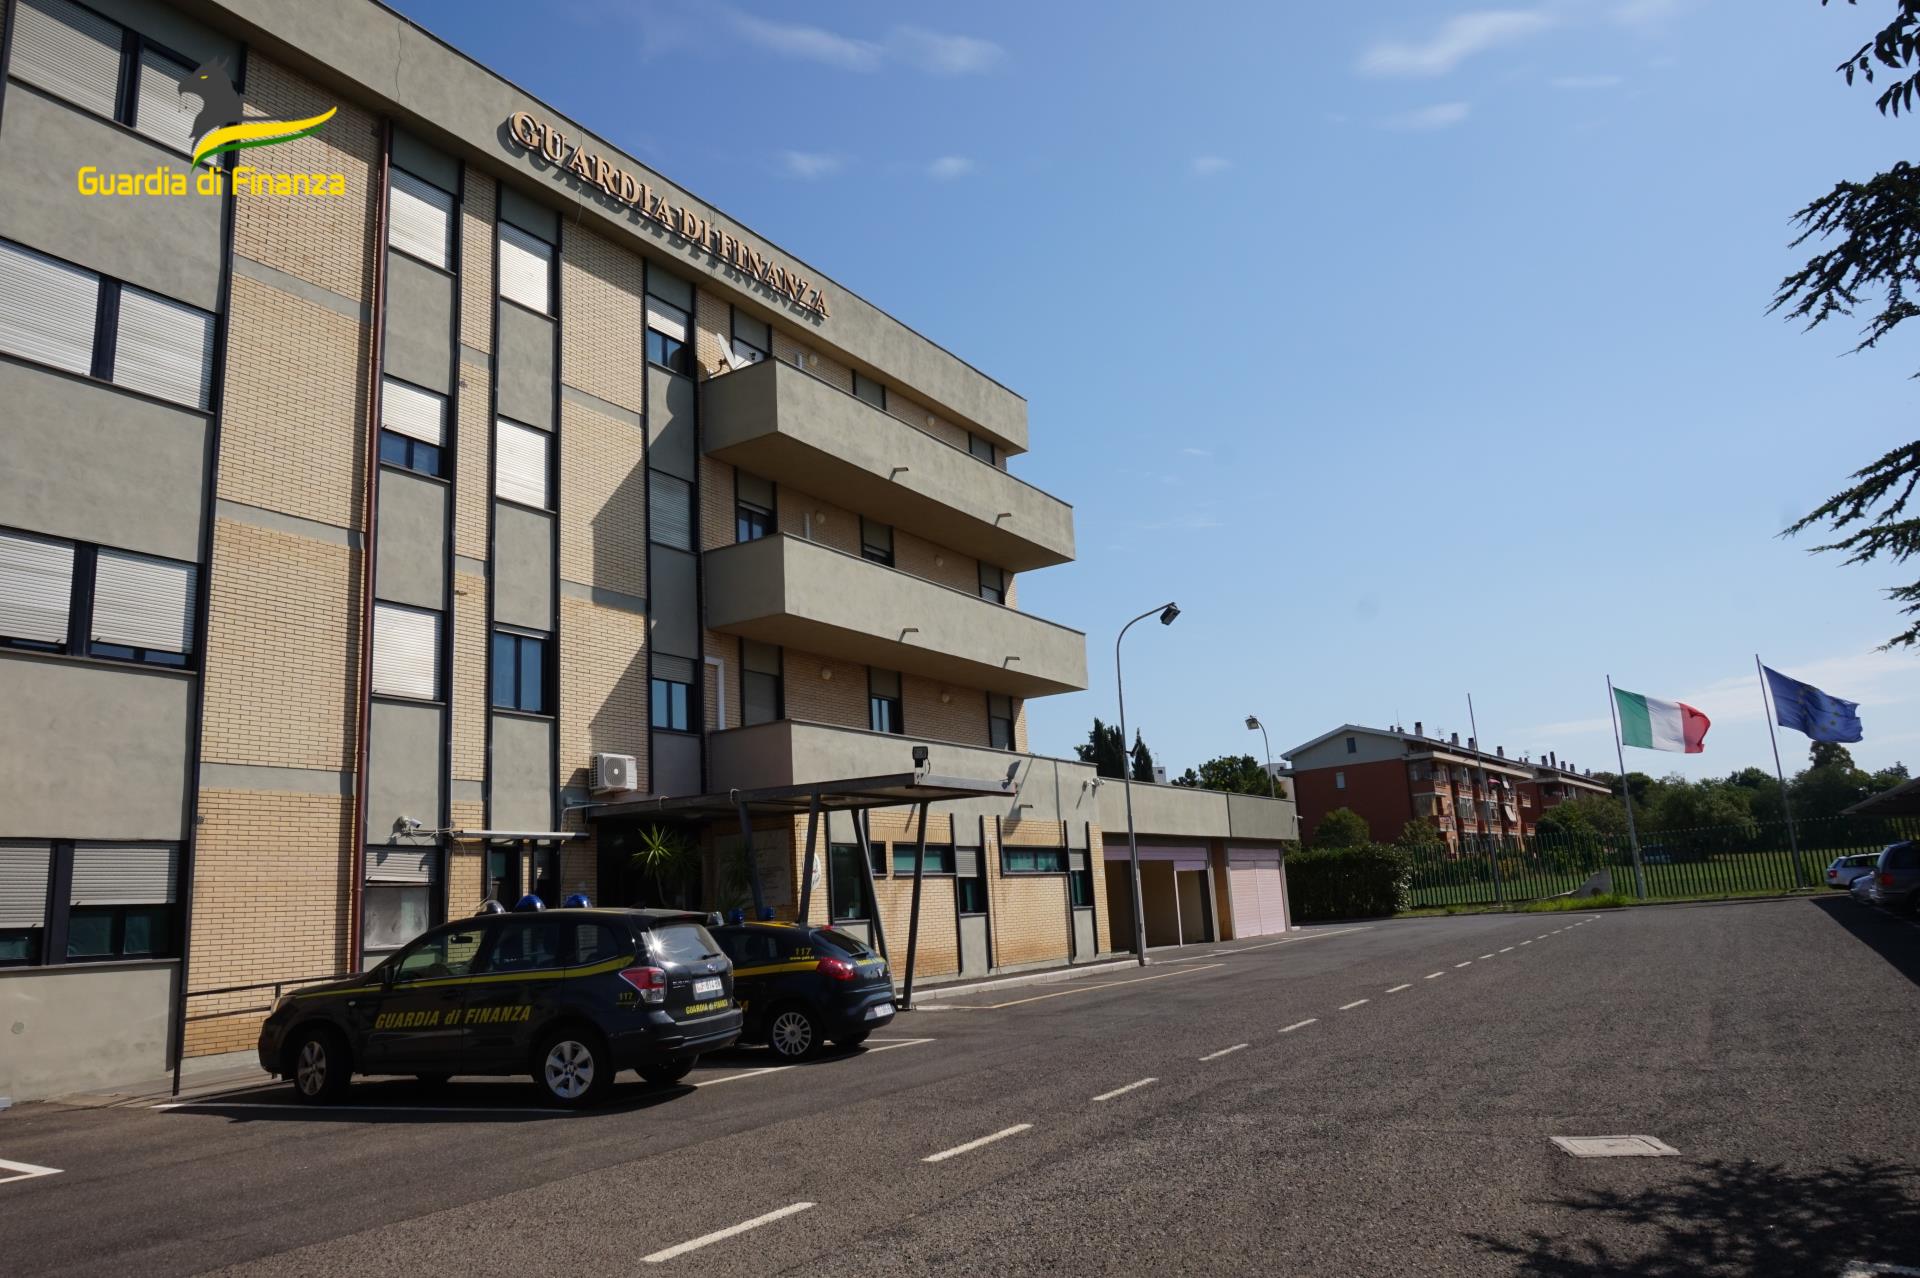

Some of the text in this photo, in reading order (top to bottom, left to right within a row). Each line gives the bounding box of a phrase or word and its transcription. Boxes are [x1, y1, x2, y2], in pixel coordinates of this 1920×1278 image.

[507, 110, 832, 319] GUARDIA DI FINANZA
[375, 1005, 533, 1029] GUARDIA di FINANZA
[685, 1003, 709, 1015] GUARDIA
